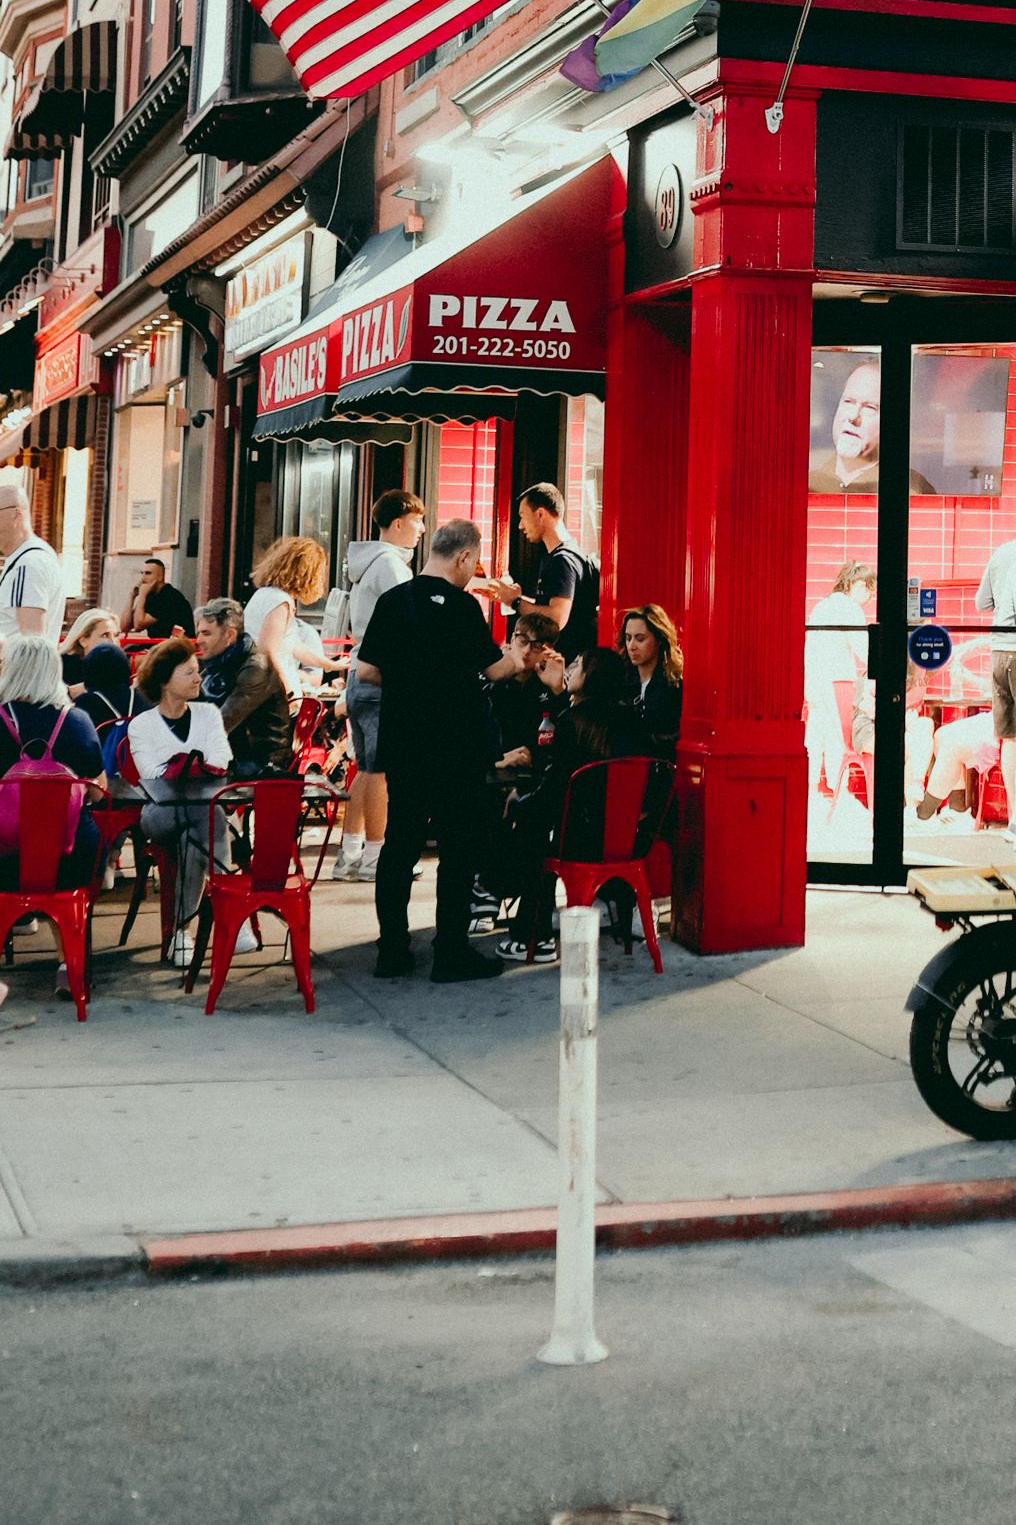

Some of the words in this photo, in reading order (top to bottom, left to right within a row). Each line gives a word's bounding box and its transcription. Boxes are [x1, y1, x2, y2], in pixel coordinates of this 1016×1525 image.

[659, 186, 676, 232] 89
[428, 293, 577, 334] PIZZA
[273, 336, 328, 404] BASILE'S
[341, 299, 396, 380] PIZZA
[432, 335, 571, 360] 201-222-5050
